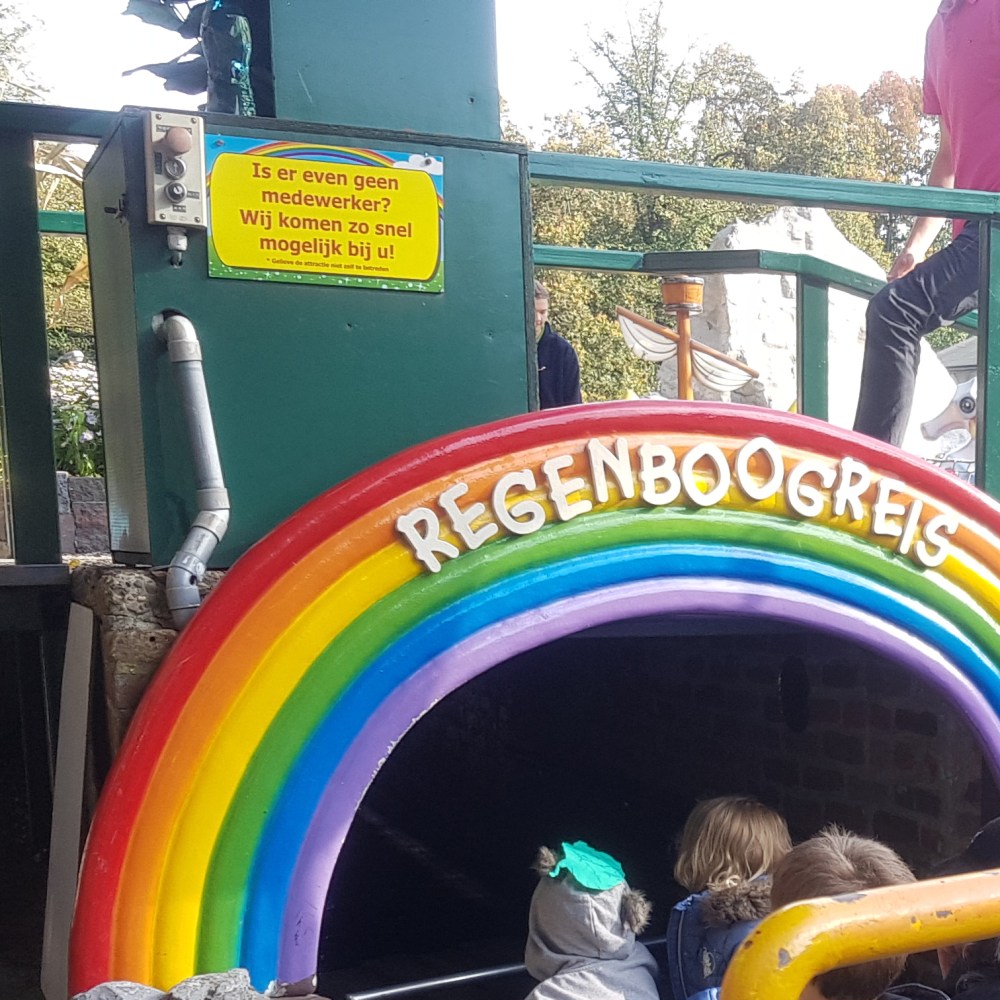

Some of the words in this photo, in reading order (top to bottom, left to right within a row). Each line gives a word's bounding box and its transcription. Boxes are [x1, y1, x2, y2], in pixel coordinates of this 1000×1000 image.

[252, 162, 271, 179] Is
[277, 166, 297, 181] er
[302, 168, 348, 186] even
[353, 171, 399, 191] geen
[261, 190, 391, 213] medewerker?
[239, 209, 272, 230] Wij
[278, 212, 342, 232] komen
[348, 220, 370, 235] zo
[375, 222, 412, 238] snel
[260, 236, 342, 258] mogelijk
[348, 241, 371, 261] bij
[377, 245, 394, 259] u!
[271, 258, 294, 266] Gelieve
[304, 260, 330, 268] attractie
[396, 437, 961, 573] REGENBOOGREIS
